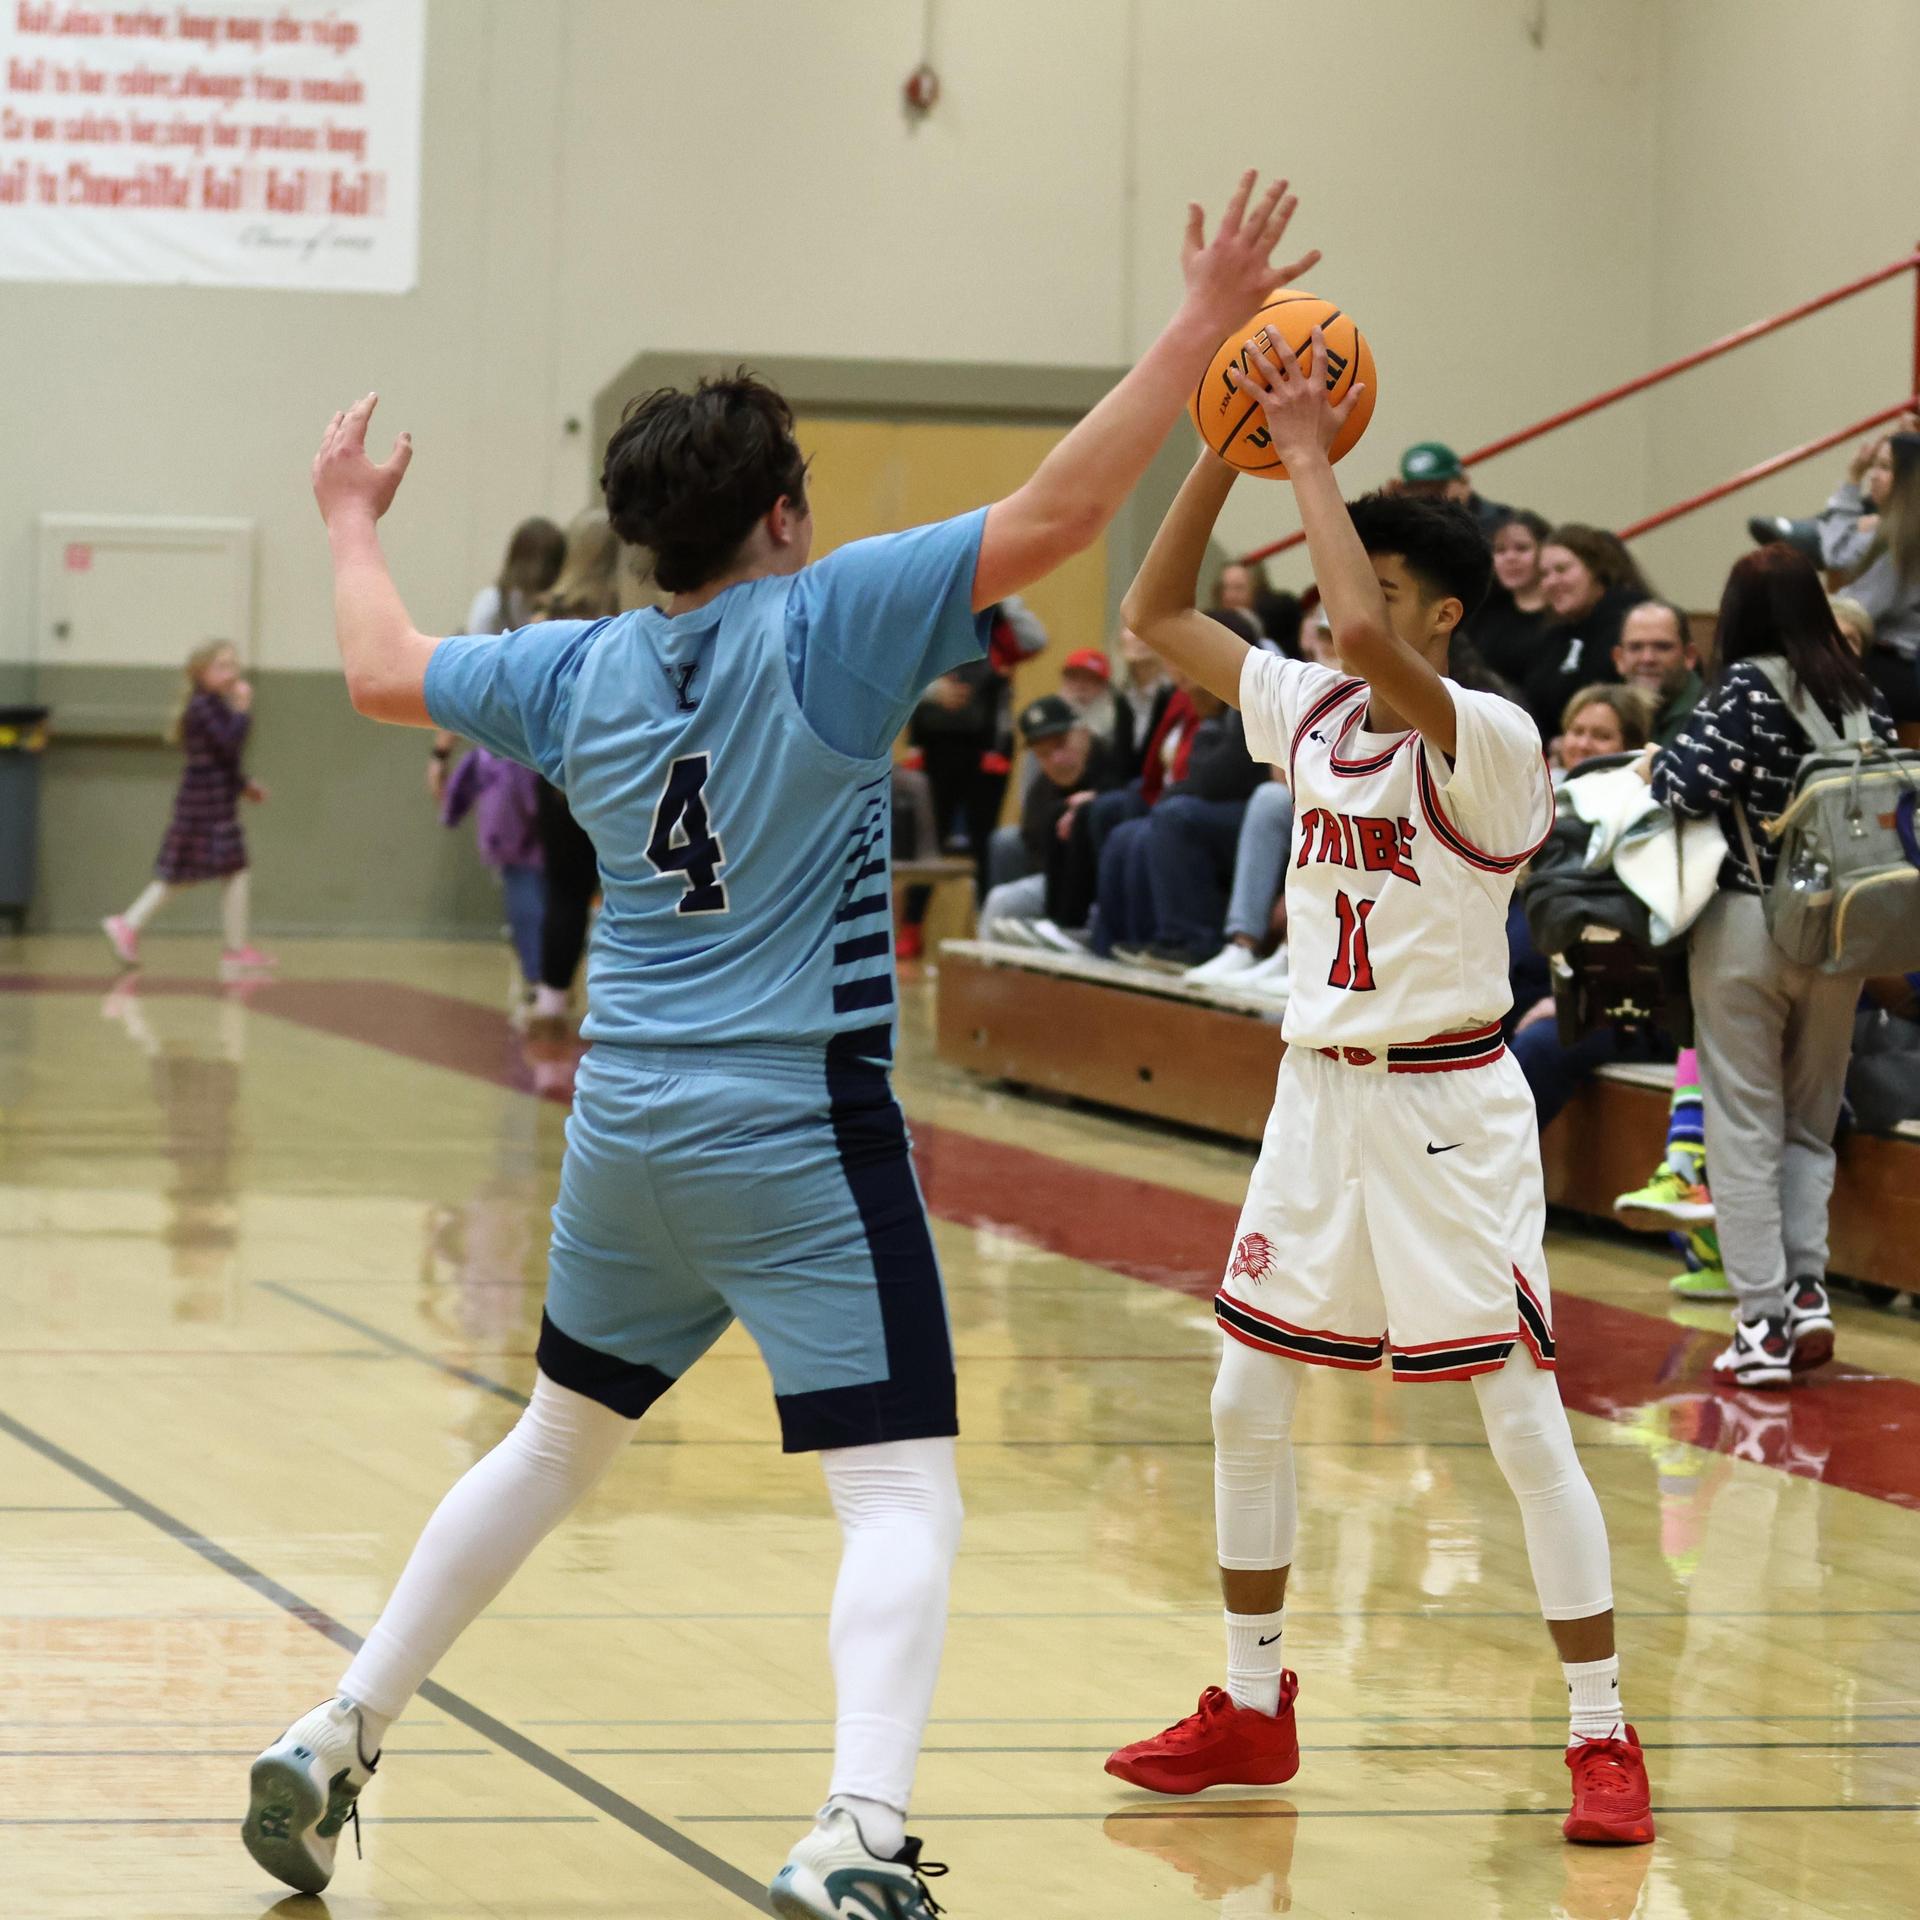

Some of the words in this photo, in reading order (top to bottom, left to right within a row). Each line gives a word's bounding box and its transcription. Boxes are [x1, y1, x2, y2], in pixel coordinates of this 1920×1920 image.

[662, 662, 700, 713] Y
[642, 750, 730, 917] 4
[1297, 806, 1422, 887] TRIBE
[1327, 889, 1377, 992] 11
